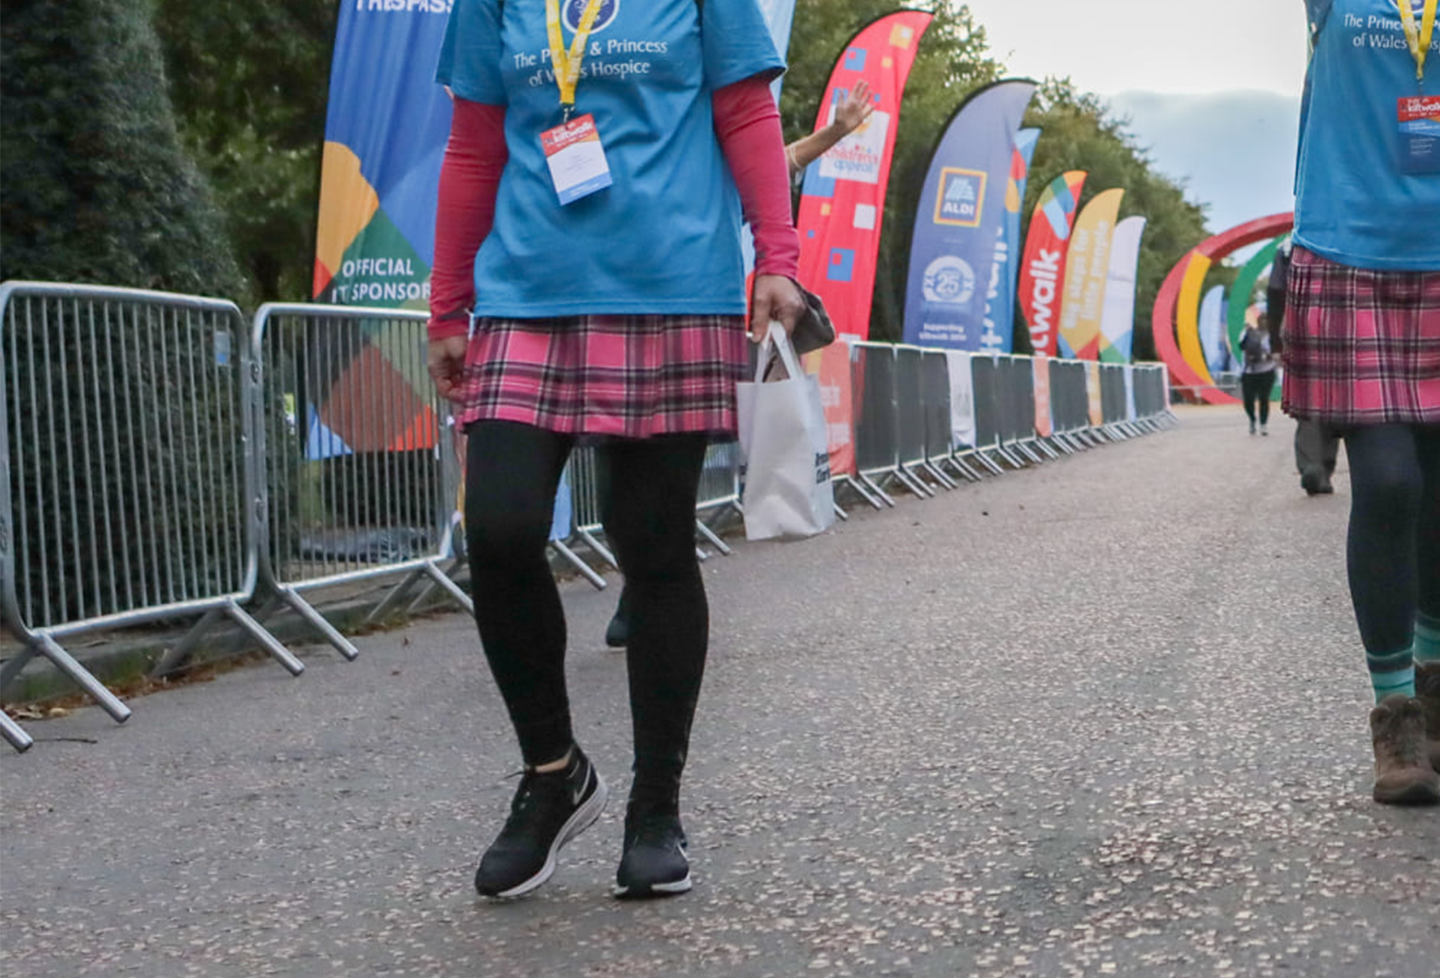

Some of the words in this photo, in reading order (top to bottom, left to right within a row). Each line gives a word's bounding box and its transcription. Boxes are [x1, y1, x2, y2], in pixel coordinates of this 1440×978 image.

[1344, 14, 1363, 28] The
[1352, 33, 1366, 48] of
[1370, 34, 1408, 50] Wales
[514, 52, 537, 69] The
[590, 40, 602, 56] &
[607, 38, 668, 54] Princess
[529, 69, 544, 87] of
[591, 59, 651, 80] Hospice
[943, 201, 975, 217] ALDI
[342, 257, 415, 278] OFFICIAL
[352, 281, 432, 302] SPONSOR
[936, 273, 960, 294] 25
